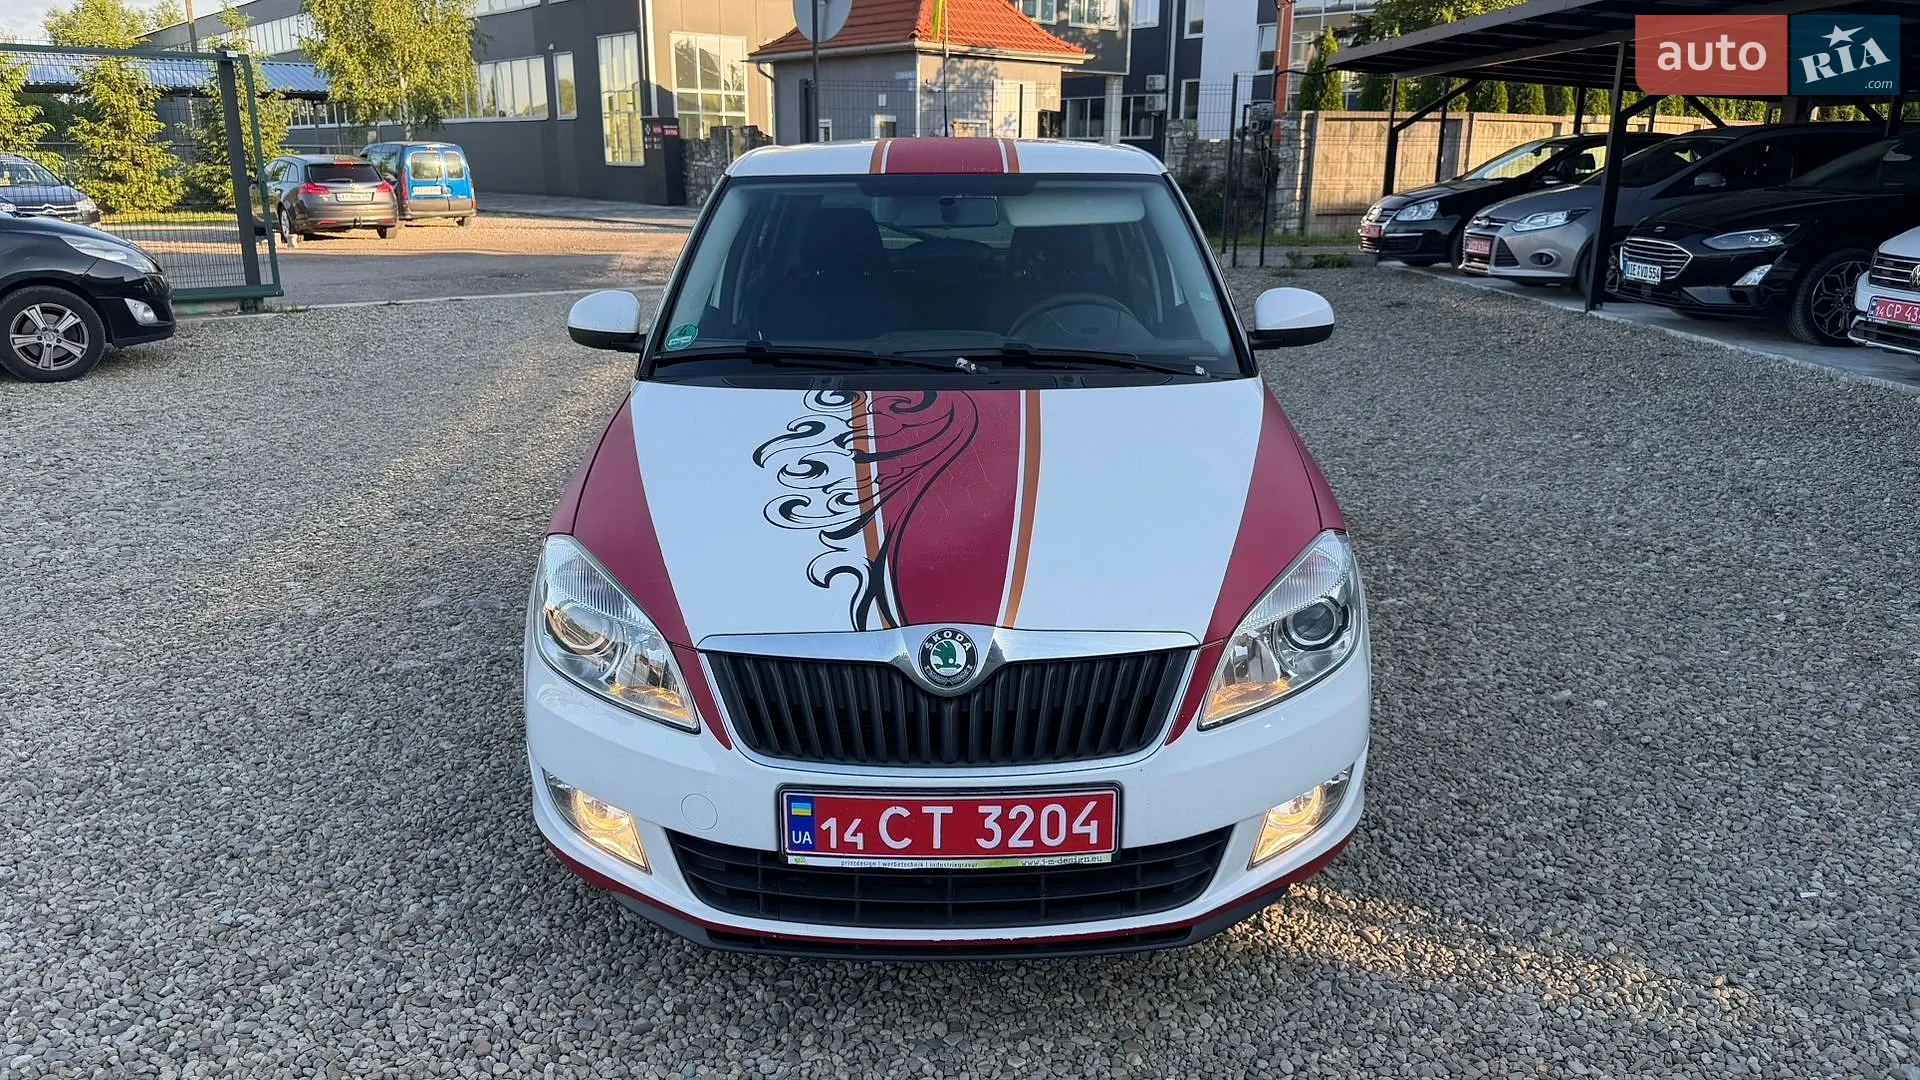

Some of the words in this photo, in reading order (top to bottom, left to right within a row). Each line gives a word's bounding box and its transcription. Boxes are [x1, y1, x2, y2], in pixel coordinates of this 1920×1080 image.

[1886, 303, 1902, 319] CP
[1904, 306, 1920, 322] 43
[820, 816, 864, 850] 14
[878, 805, 953, 850] CT
[975, 800, 1099, 850] 3204
[791, 830, 813, 846] UA
